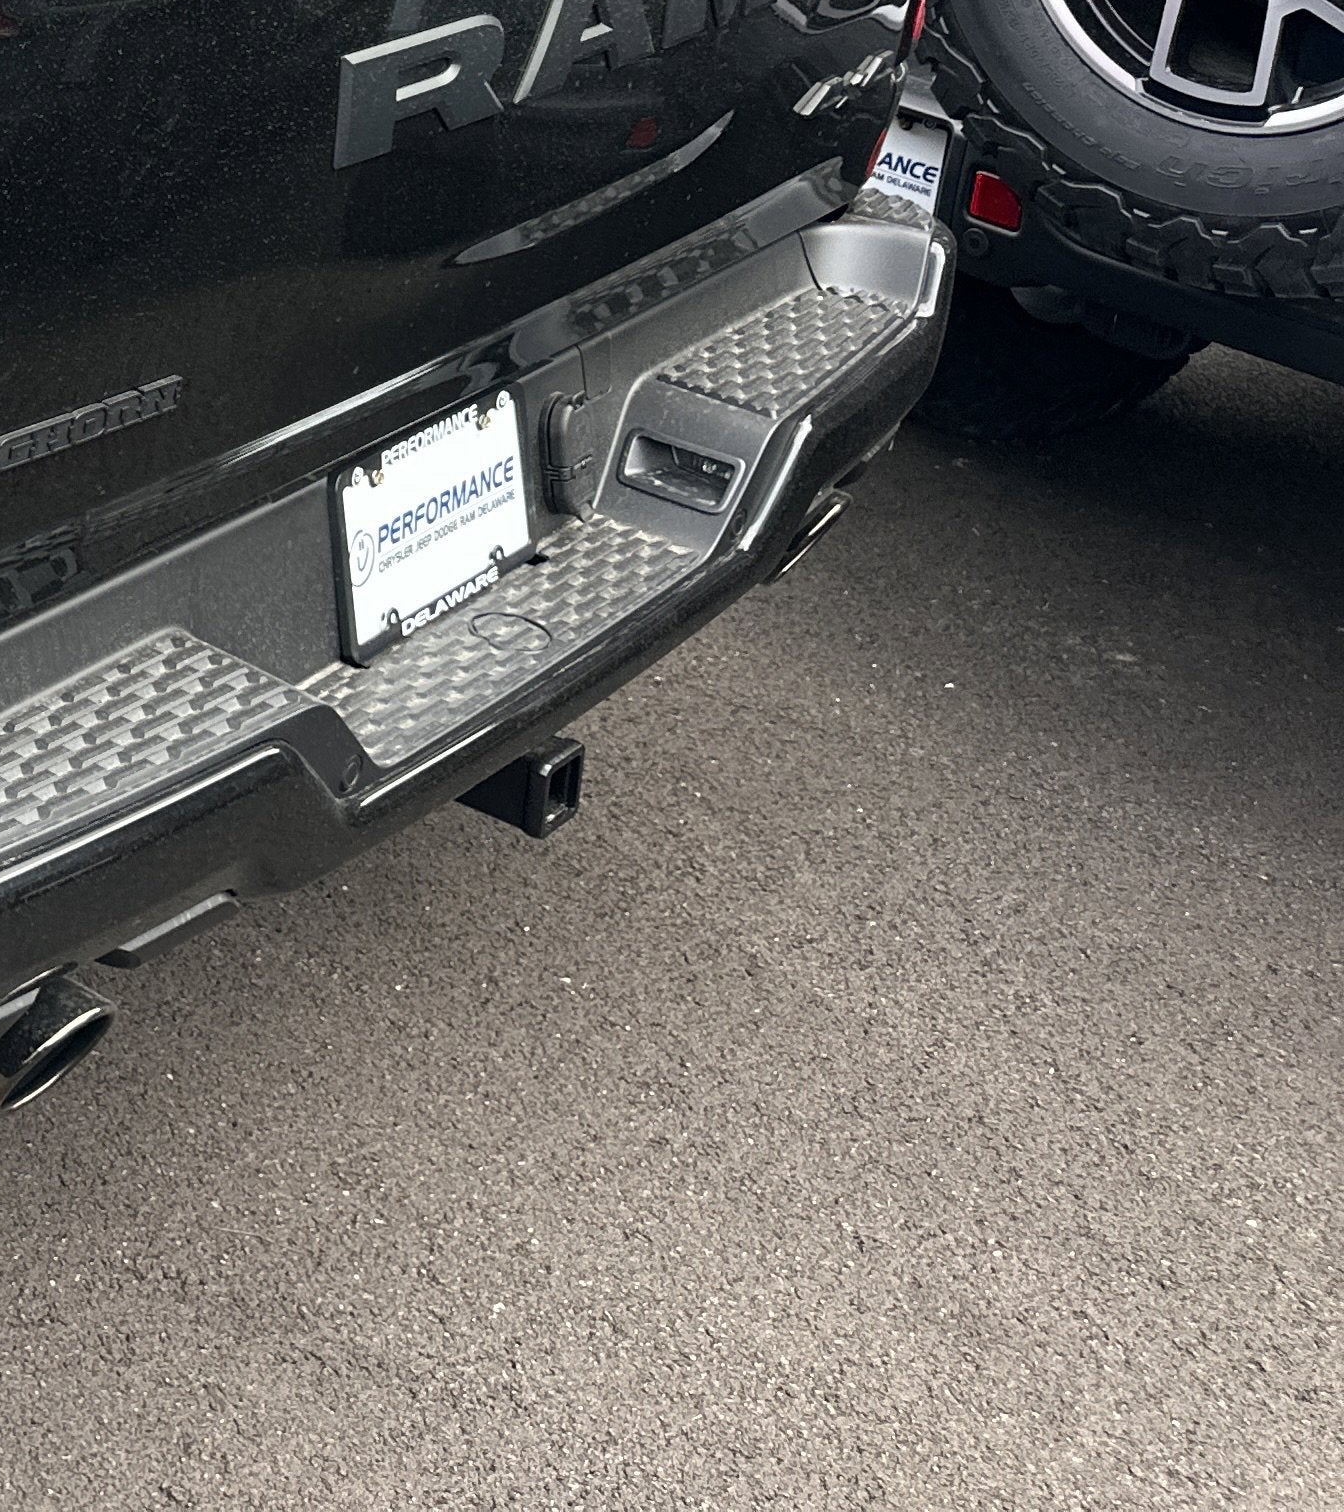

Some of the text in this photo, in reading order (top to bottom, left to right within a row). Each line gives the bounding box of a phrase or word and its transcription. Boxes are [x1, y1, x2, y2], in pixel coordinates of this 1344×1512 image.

[886, 175, 932, 197] DELAWARE
[381, 404, 478, 465] PERFORMANCE
[378, 455, 514, 553] PERFORMANCE
[378, 489, 515, 573] CHRYSLER JEEP DODGE RAM DELAWARE
[401, 565, 499, 637] DELAWARE
